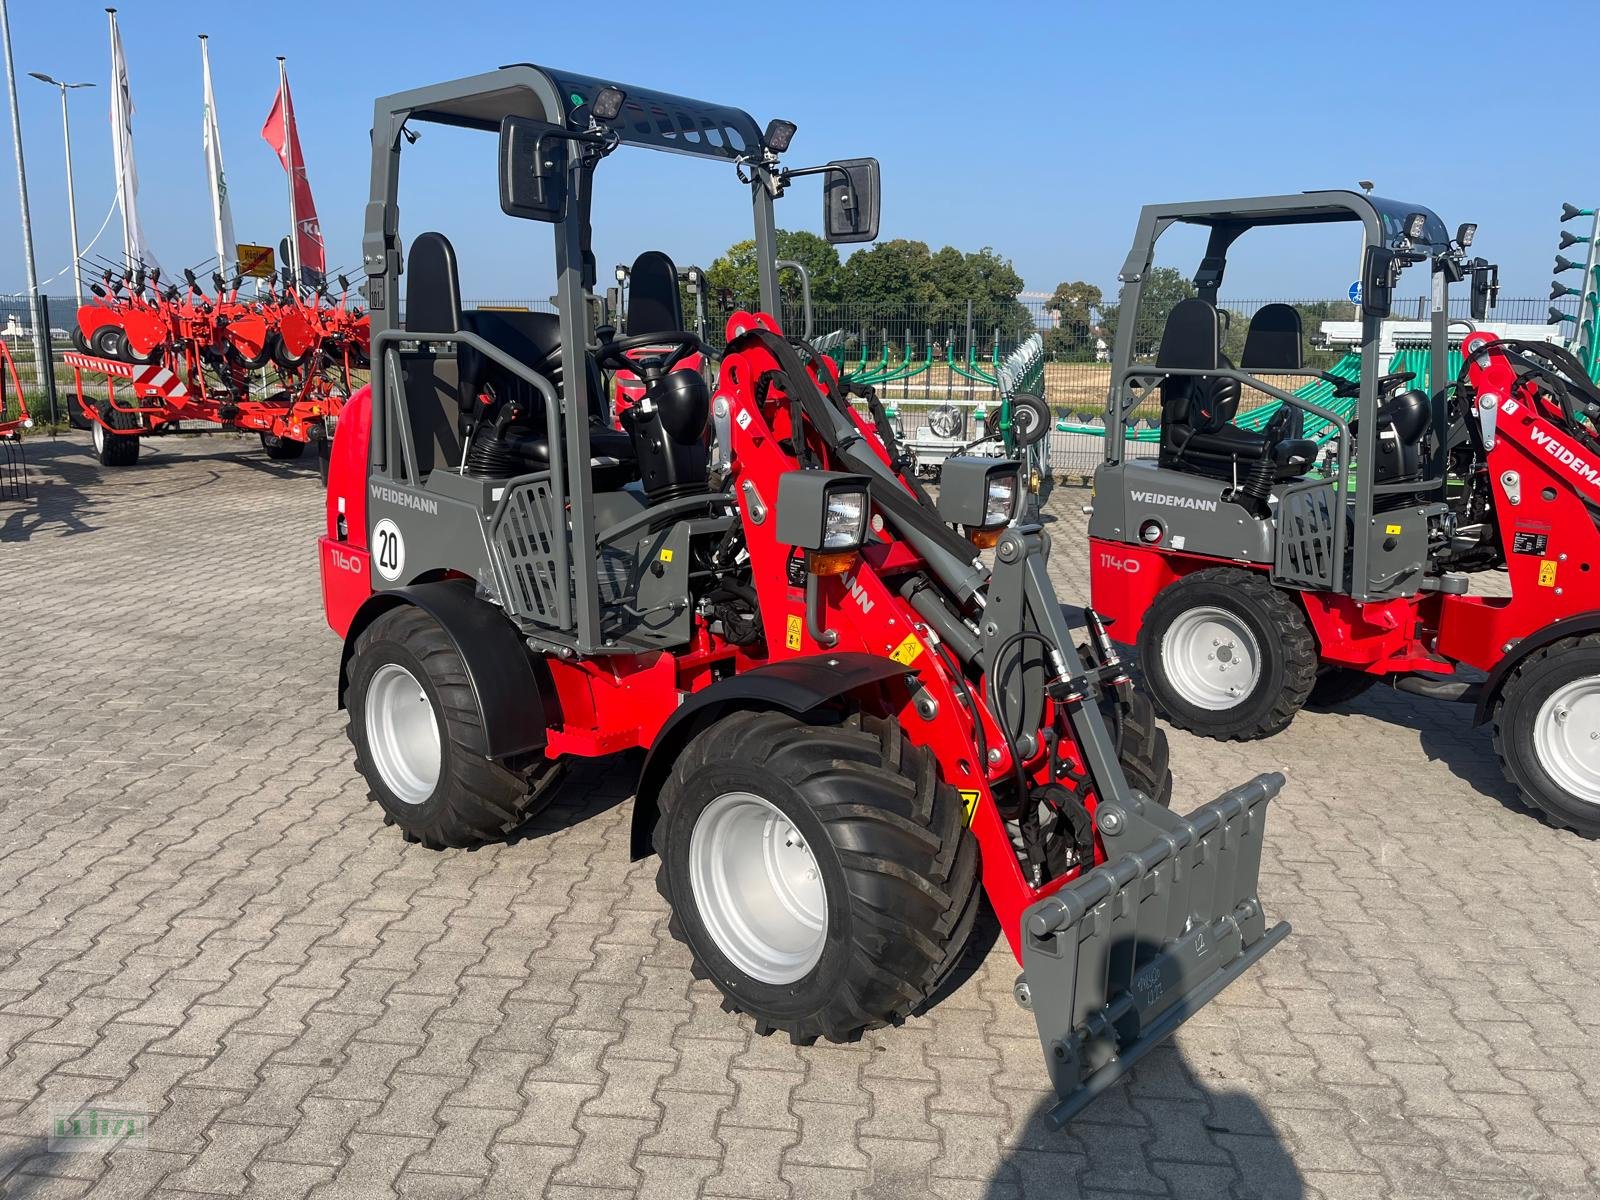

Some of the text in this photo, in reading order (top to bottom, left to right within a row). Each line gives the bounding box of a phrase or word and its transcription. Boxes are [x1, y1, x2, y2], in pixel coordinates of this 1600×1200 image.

[370, 484, 438, 515] WEIDEMANN
[1130, 490, 1217, 512] WEIDEMANN
[331, 549, 361, 574] 1160
[379, 529, 398, 570] 20
[1100, 553, 1140, 573] 1140
